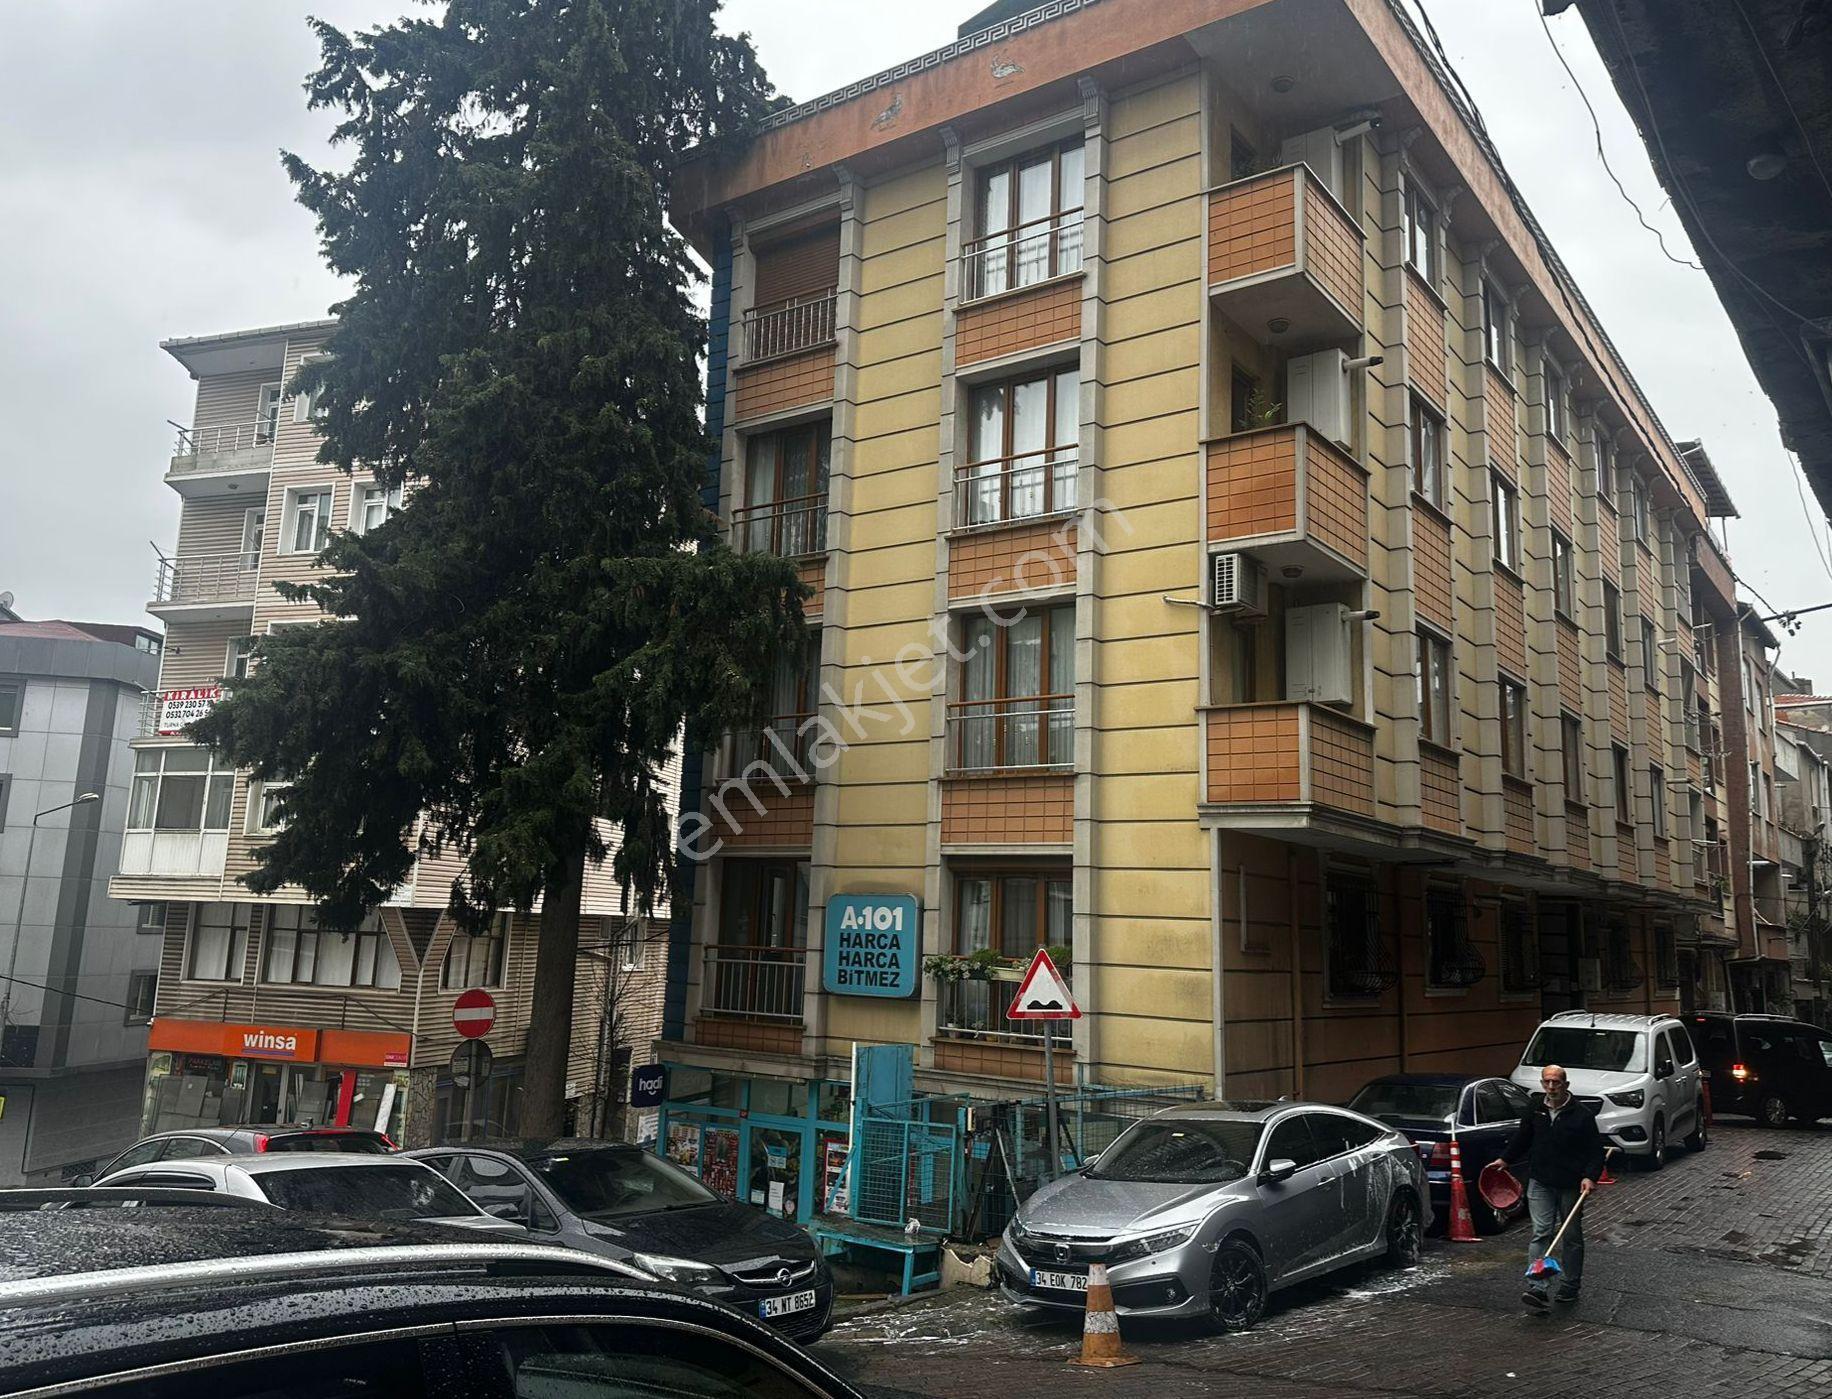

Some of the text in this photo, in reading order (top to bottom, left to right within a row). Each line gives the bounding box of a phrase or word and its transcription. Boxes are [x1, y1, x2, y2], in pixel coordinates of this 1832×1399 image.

[839, 932, 901, 950] HARCA
[838, 950, 901, 969] HARCA
[243, 1030, 297, 1050] winsa
[639, 1076, 663, 1092] hadi
[1036, 1272, 1047, 1285] 34
[1070, 1275, 1088, 1290] 782
[766, 1292, 814, 1315] 34 NT 8652
